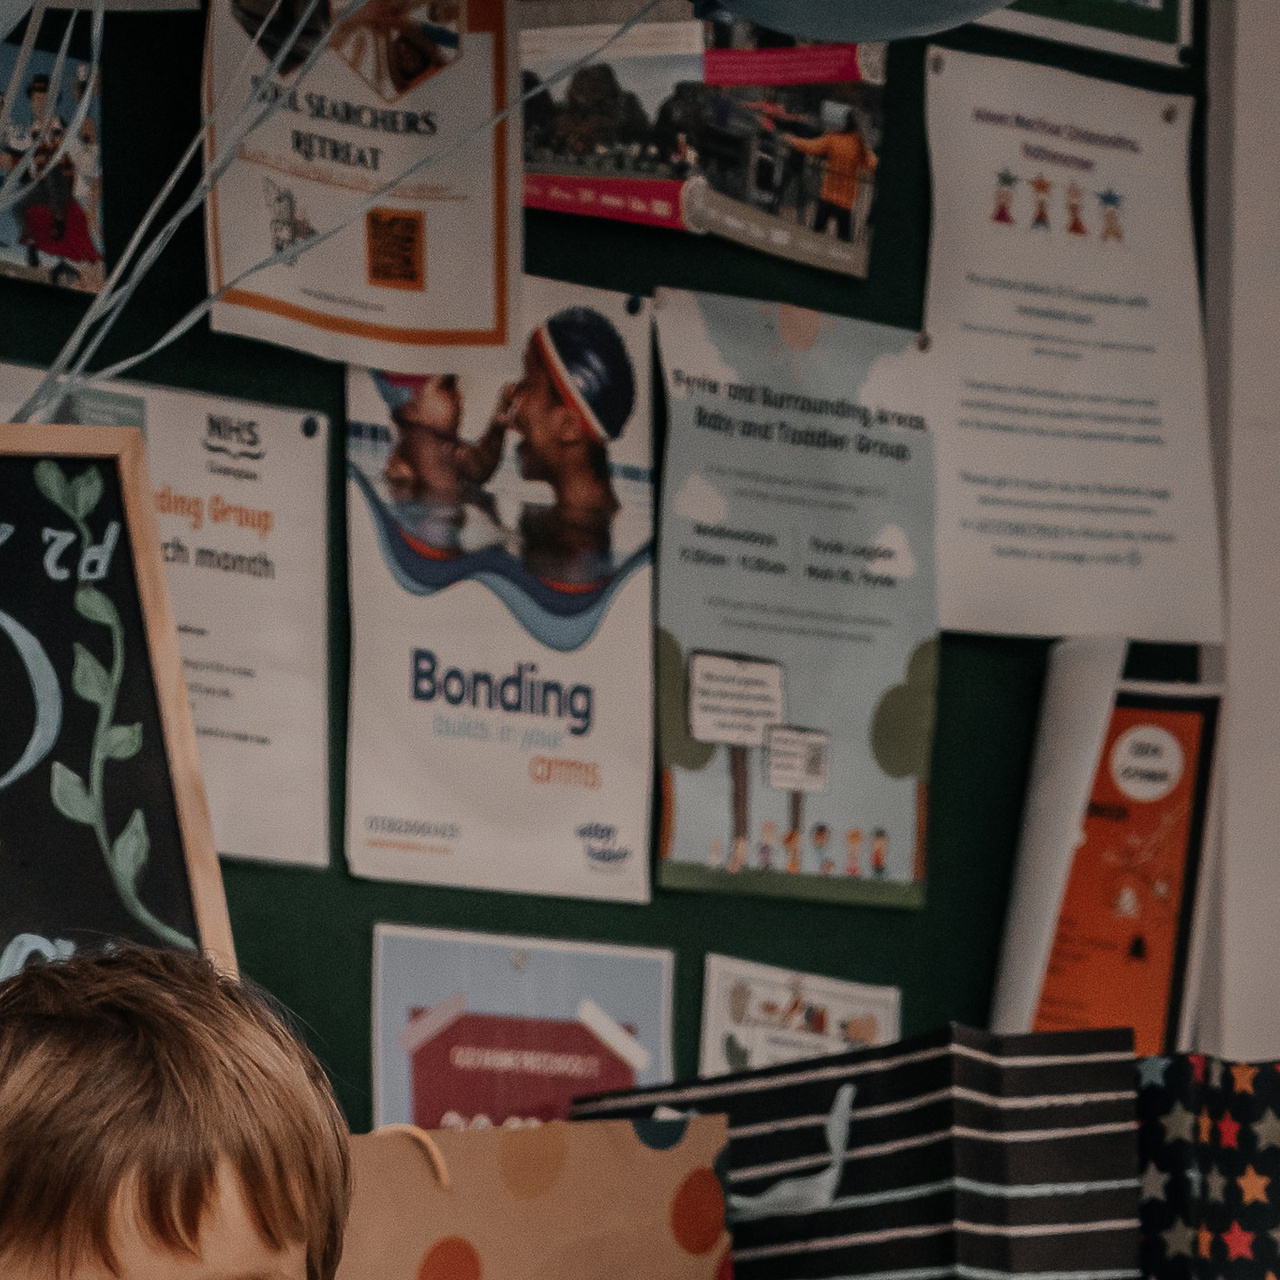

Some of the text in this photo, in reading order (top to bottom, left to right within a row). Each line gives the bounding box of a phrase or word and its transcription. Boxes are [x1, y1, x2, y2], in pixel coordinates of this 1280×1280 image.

[305, 92, 438, 136] SEARCHERS
[291, 130, 380, 170] RETREAT
[207, 414, 261, 447] NHS
[410, 647, 594, 737] Bonding
